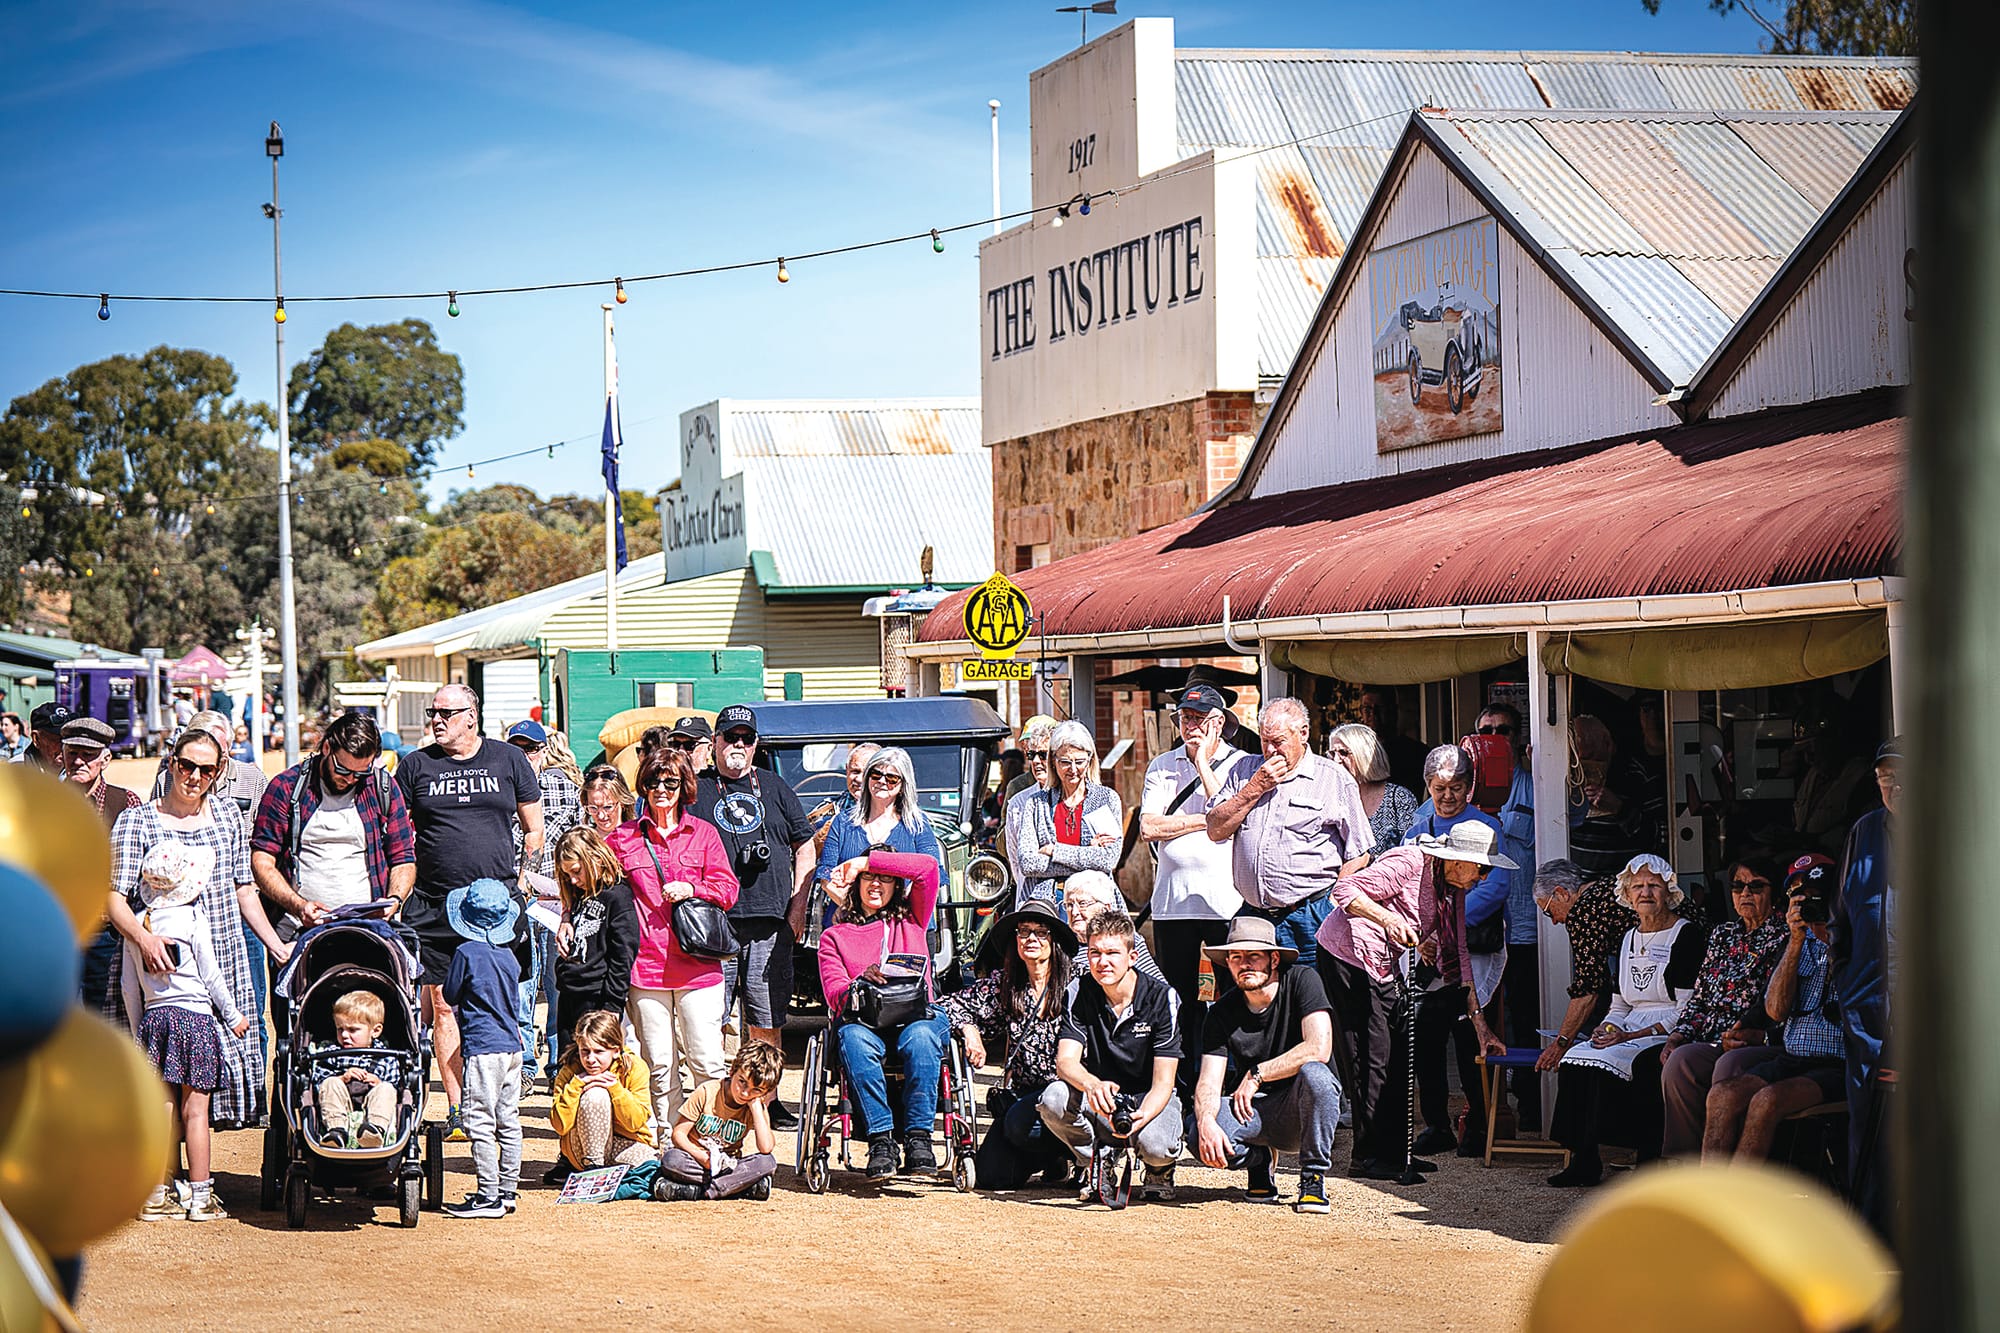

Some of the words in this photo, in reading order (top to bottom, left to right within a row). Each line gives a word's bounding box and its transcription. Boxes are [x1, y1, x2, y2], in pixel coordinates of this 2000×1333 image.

[1068, 133, 1096, 174] 1917
[987, 276, 1038, 361] THE
[1048, 216, 1205, 344] INSTITUTE
[1371, 240, 1427, 337] LOXTON
[1433, 221, 1495, 308] GARAGE
[965, 663, 1030, 678] GARAGE
[439, 770, 462, 780] ROLLS
[463, 768, 488, 777] ROYCE
[428, 776, 500, 797] MERLIN
[695, 1113, 723, 1135] NEW
